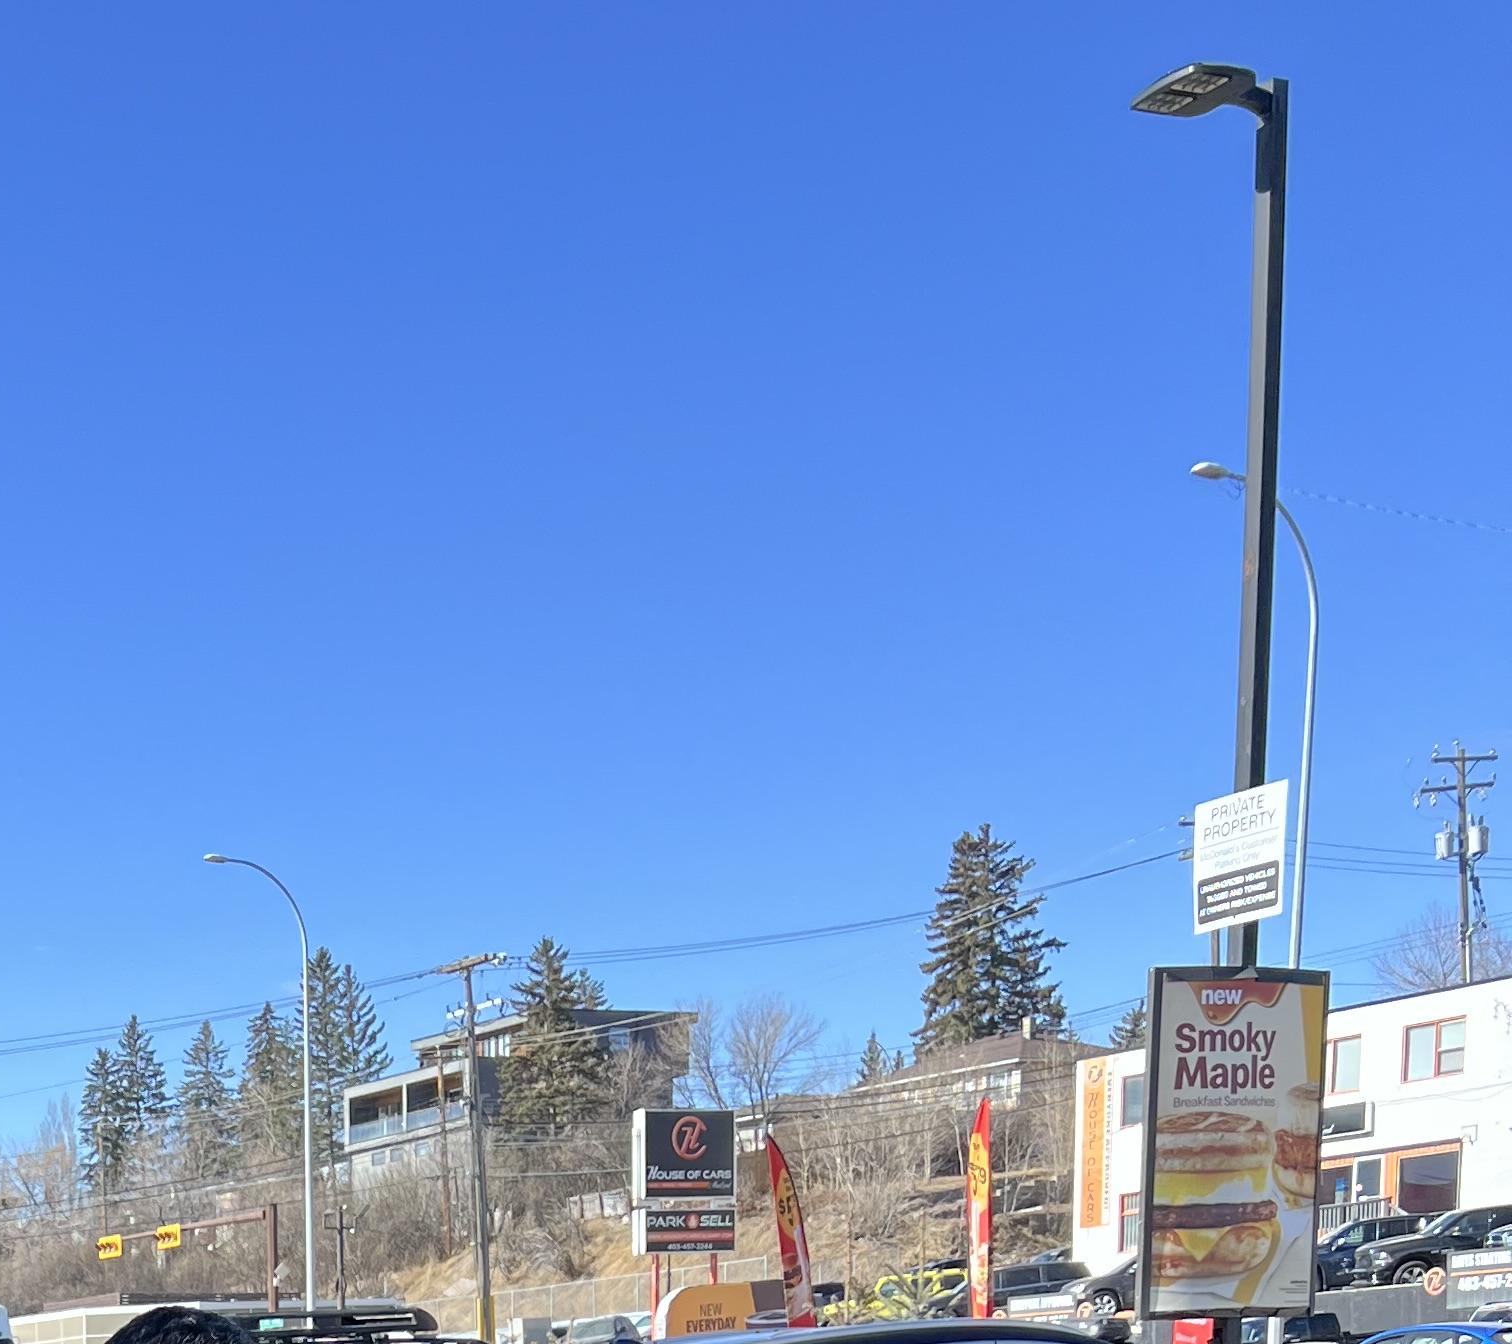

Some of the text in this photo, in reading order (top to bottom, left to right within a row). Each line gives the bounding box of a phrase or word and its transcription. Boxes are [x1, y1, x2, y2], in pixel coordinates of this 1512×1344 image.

[1211, 793, 1266, 821] PRIVATE
[1202, 808, 1277, 841] PROPERTY
[1201, 987, 1243, 1006] new
[1175, 1021, 1276, 1061] Smoky
[1174, 1054, 1275, 1094] Maple
[1173, 1095, 1276, 1108] Breakfast Sandwiches
[686, 1169, 702, 1179] OF
[702, 1169, 732, 1179] CARS
[647, 1214, 733, 1228] PARK SELL
[699, 1302, 723, 1317] NEW
[686, 1317, 737, 1333] EVERYDAY
